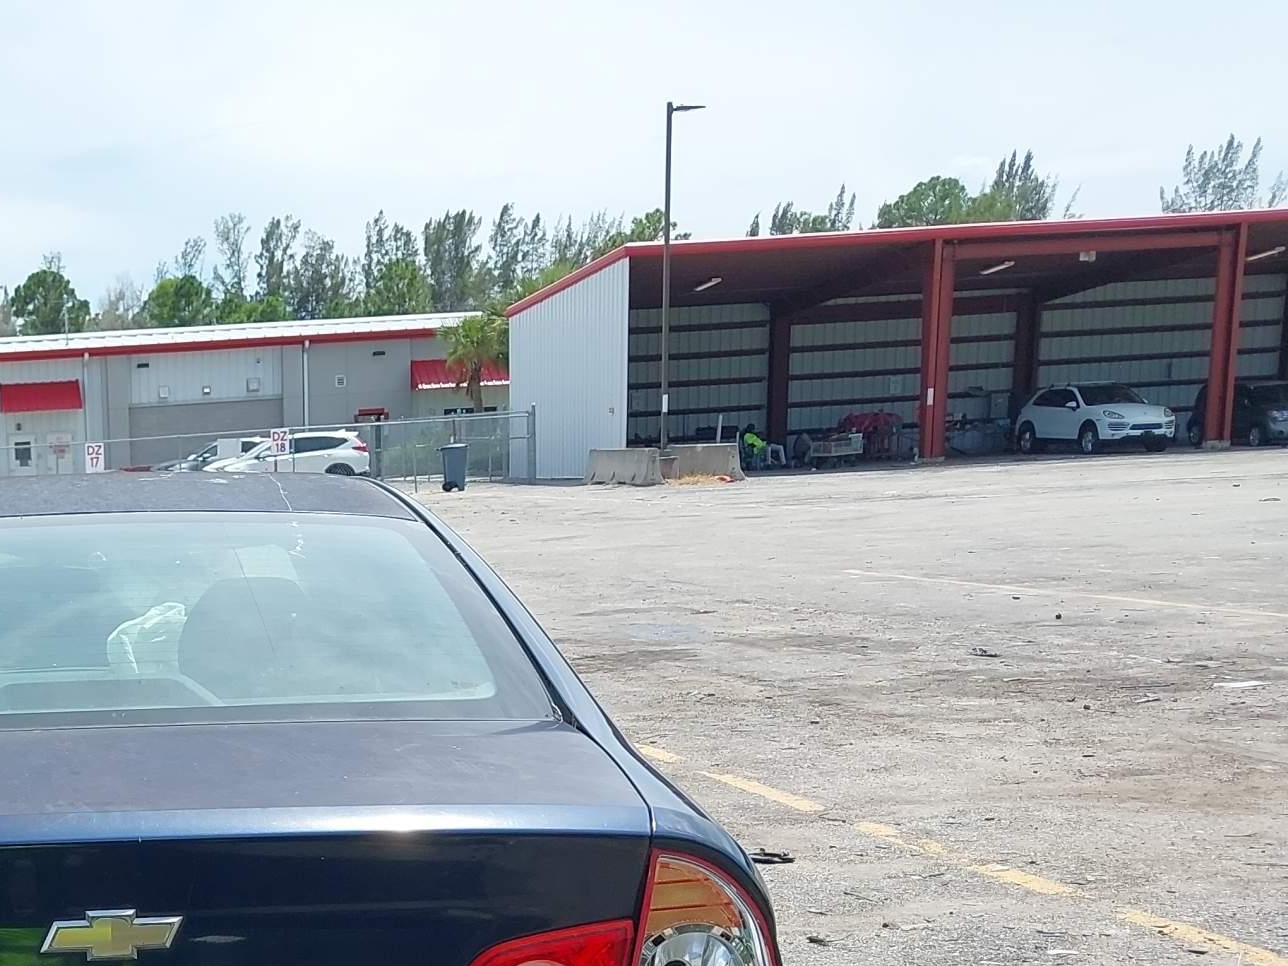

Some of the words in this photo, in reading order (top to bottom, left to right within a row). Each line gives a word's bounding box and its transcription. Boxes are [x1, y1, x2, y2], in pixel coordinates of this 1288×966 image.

[272, 431, 288, 442] DZ
[87, 444, 102, 456] DZ
[275, 443, 286, 453] 18
[90, 456, 100, 468] 17
